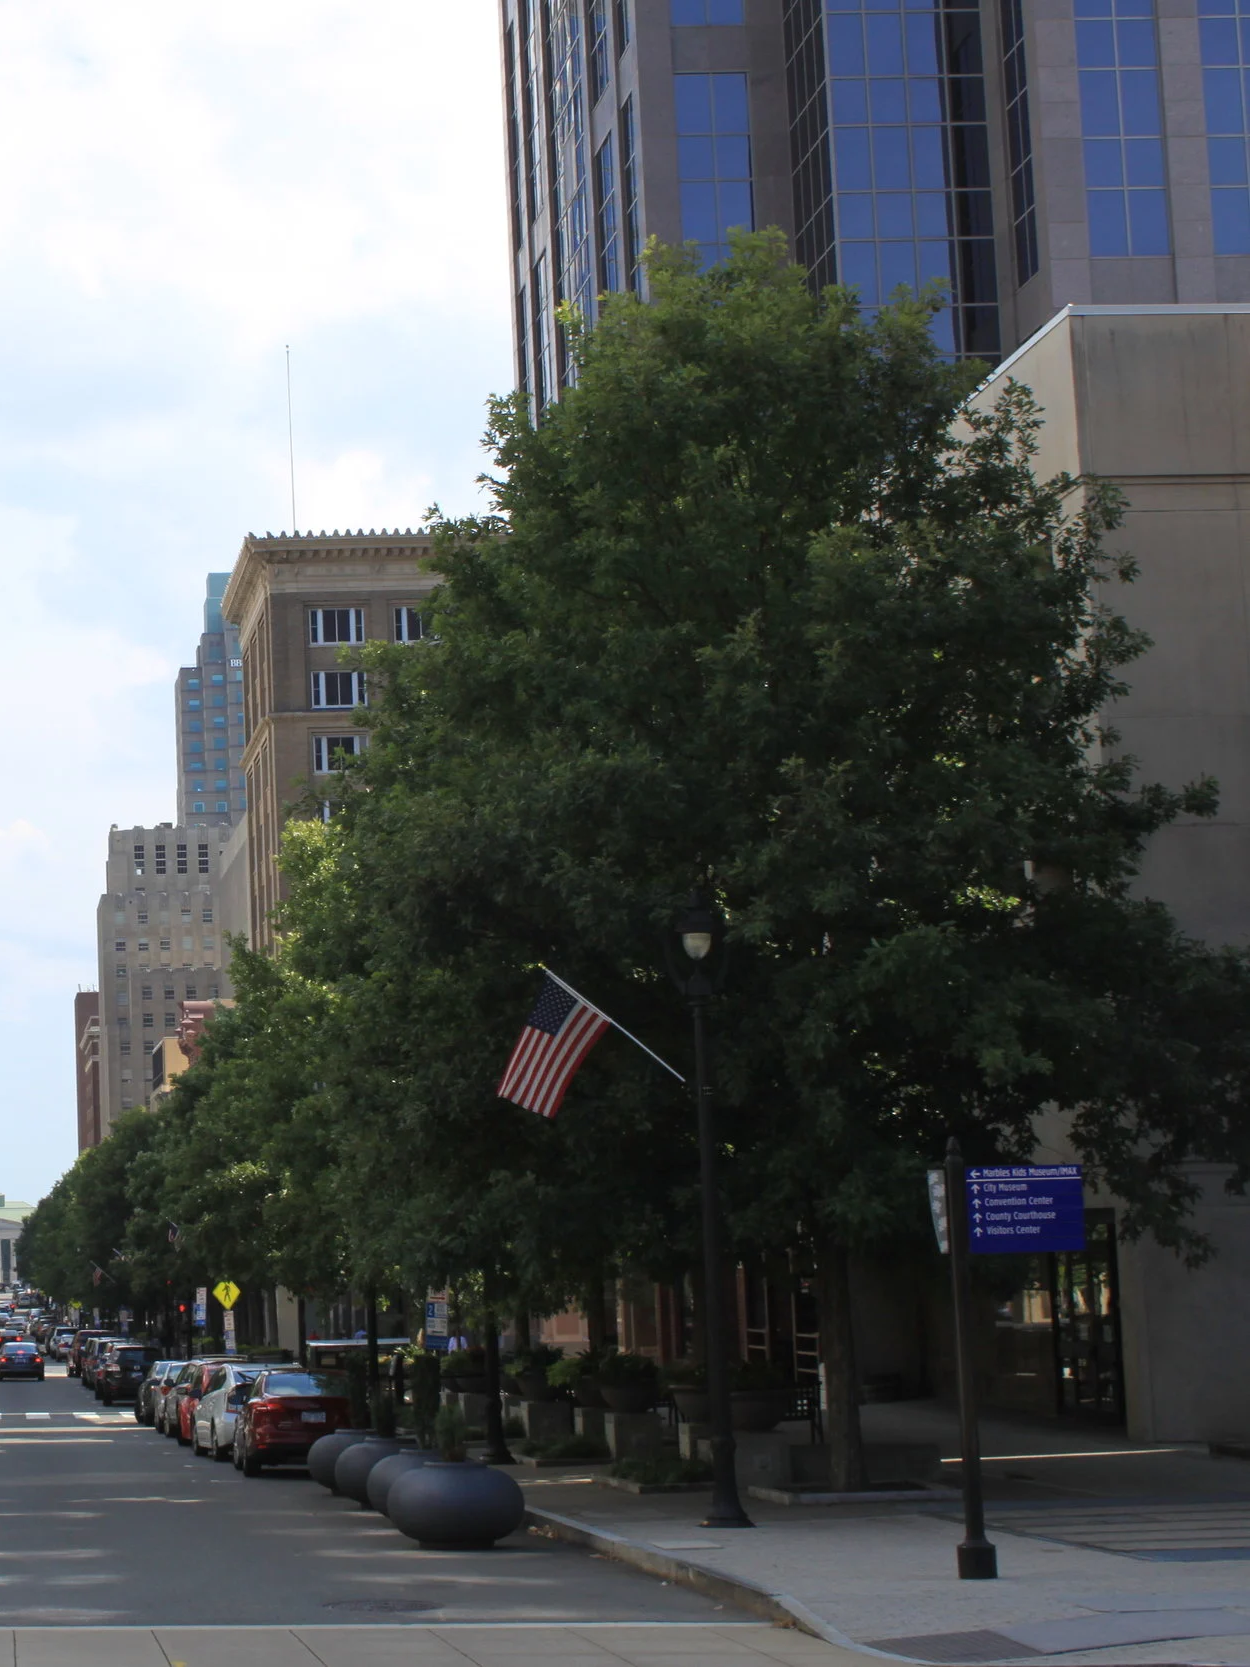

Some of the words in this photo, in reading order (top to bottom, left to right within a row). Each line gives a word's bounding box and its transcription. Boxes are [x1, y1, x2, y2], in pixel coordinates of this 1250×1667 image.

[983, 1168, 1010, 1177] Marbles
[1012, 1167, 1027, 1177] Kids
[1028, 1167, 1077, 1176] Museum/IMAX
[983, 1183, 997, 1194] City
[998, 1183, 1028, 1192] Museum
[985, 1197, 1027, 1206] Convention
[1028, 1196, 1054, 1205] Center
[985, 1212, 1012, 1222] County
[1013, 1211, 1056, 1221] Courthouse
[987, 1226, 1015, 1235] Visitors
[1016, 1225, 1041, 1234] Center
